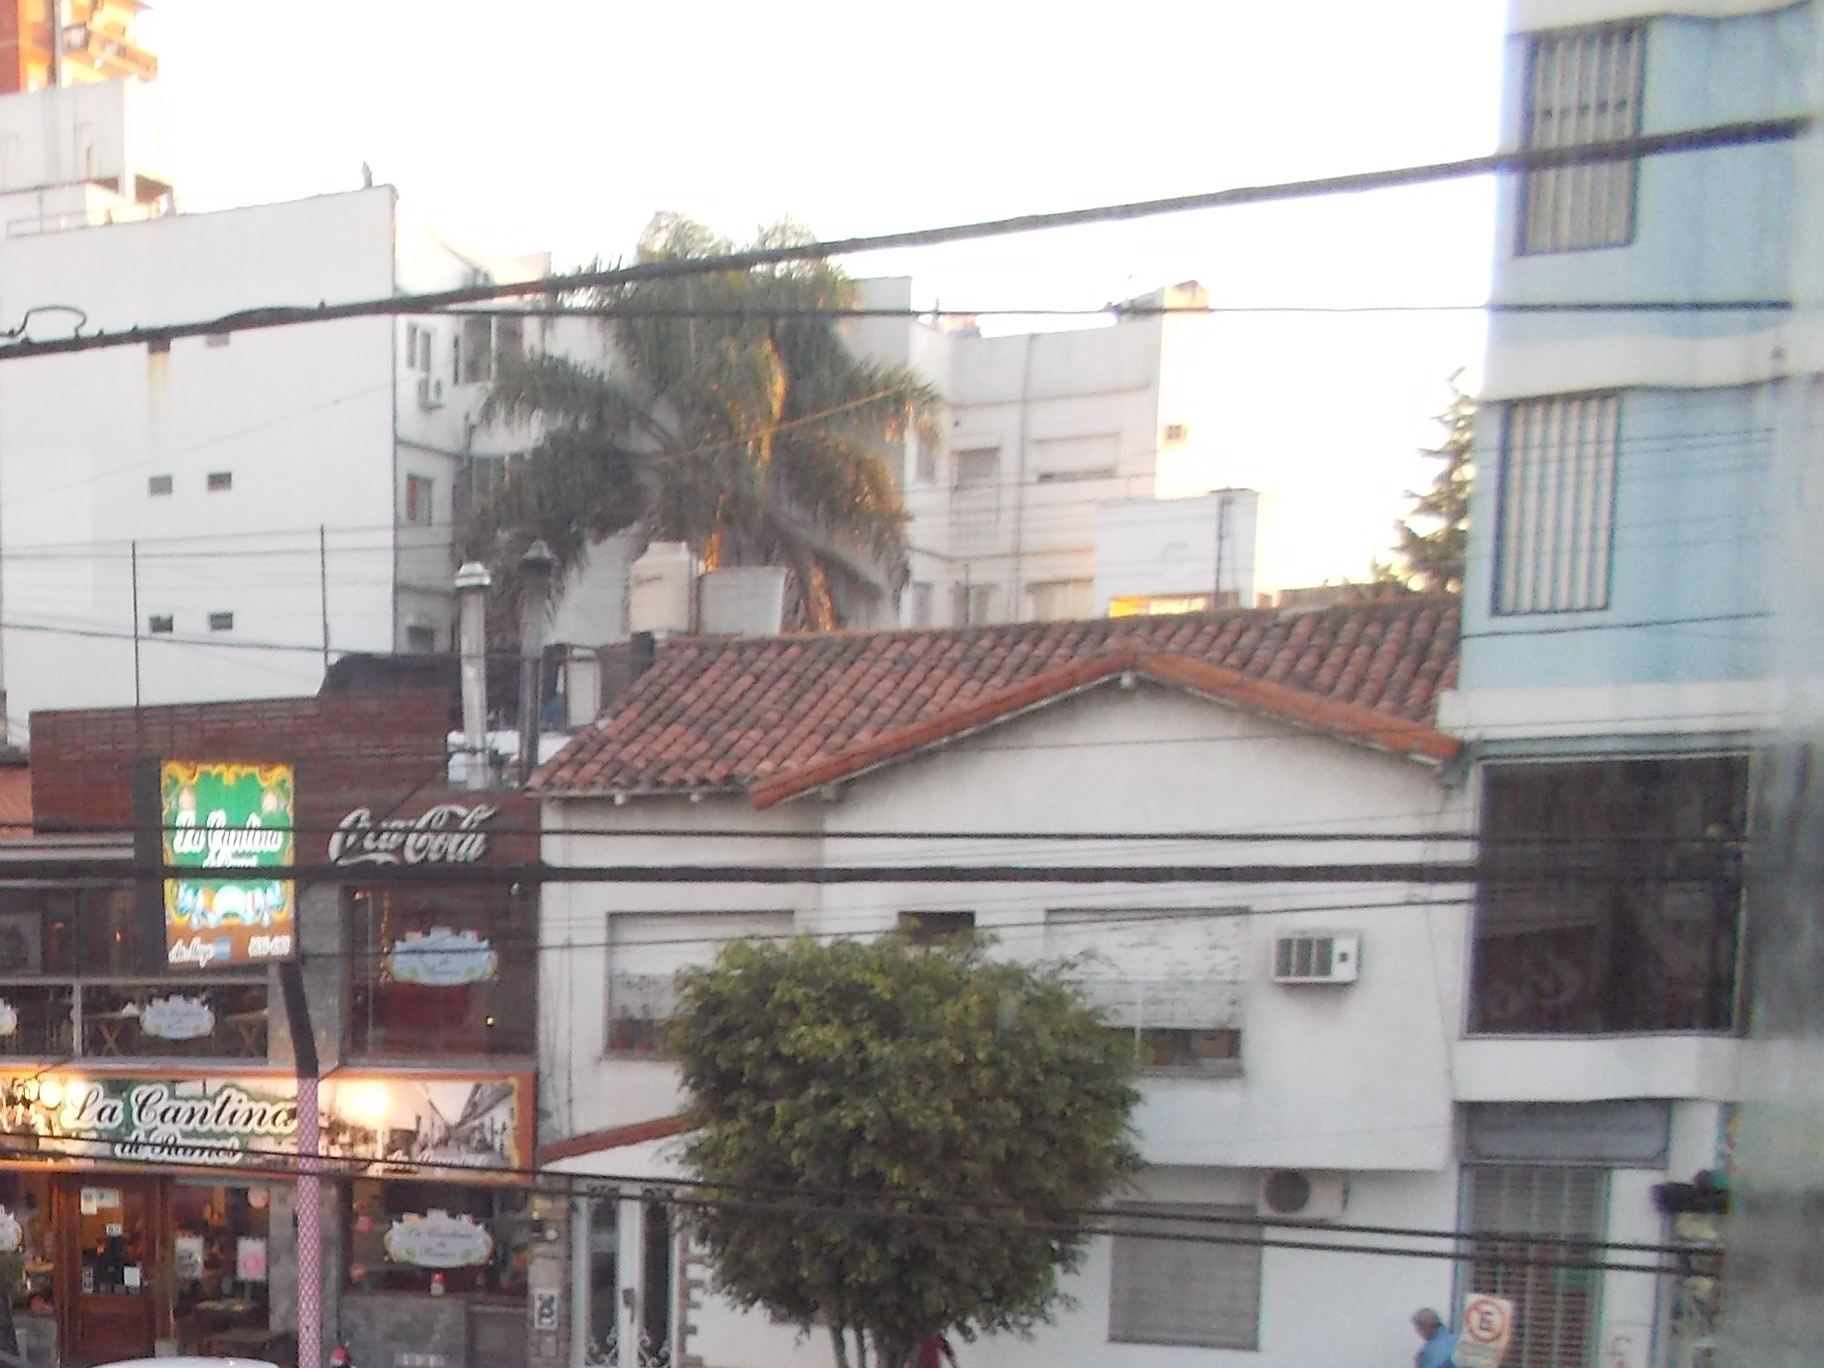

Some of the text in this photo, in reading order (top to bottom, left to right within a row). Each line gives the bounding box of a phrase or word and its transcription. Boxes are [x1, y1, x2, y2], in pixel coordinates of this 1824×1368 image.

[329, 803, 498, 867] Coca-Cola
[72, 1083, 297, 1132] La Cantina
